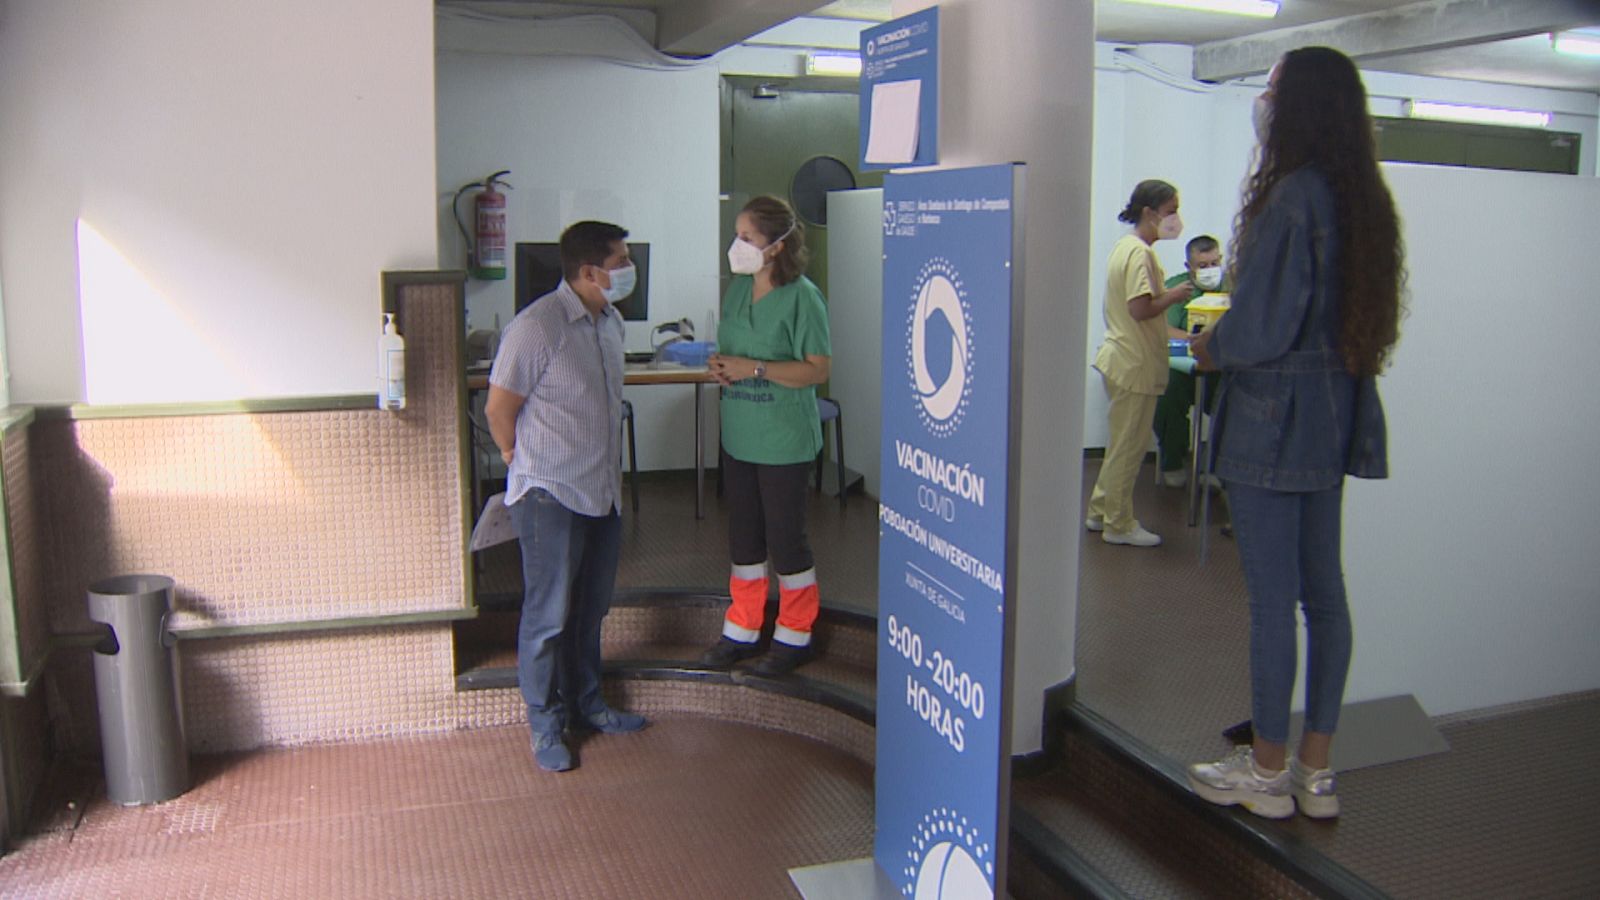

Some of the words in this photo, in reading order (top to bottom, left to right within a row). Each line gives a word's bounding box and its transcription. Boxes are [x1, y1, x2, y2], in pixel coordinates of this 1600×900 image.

[895, 439, 985, 507] VACINACIÓN
[917, 484, 956, 523] COVID
[879, 503, 928, 549] POBOACIÓN
[928, 533, 1004, 594] UNIVERSITARIA
[927, 587, 938, 605] DE
[938, 594, 966, 625] GALICIA
[887, 614, 923, 668] 9:00
[906, 674, 965, 753] HORAS
